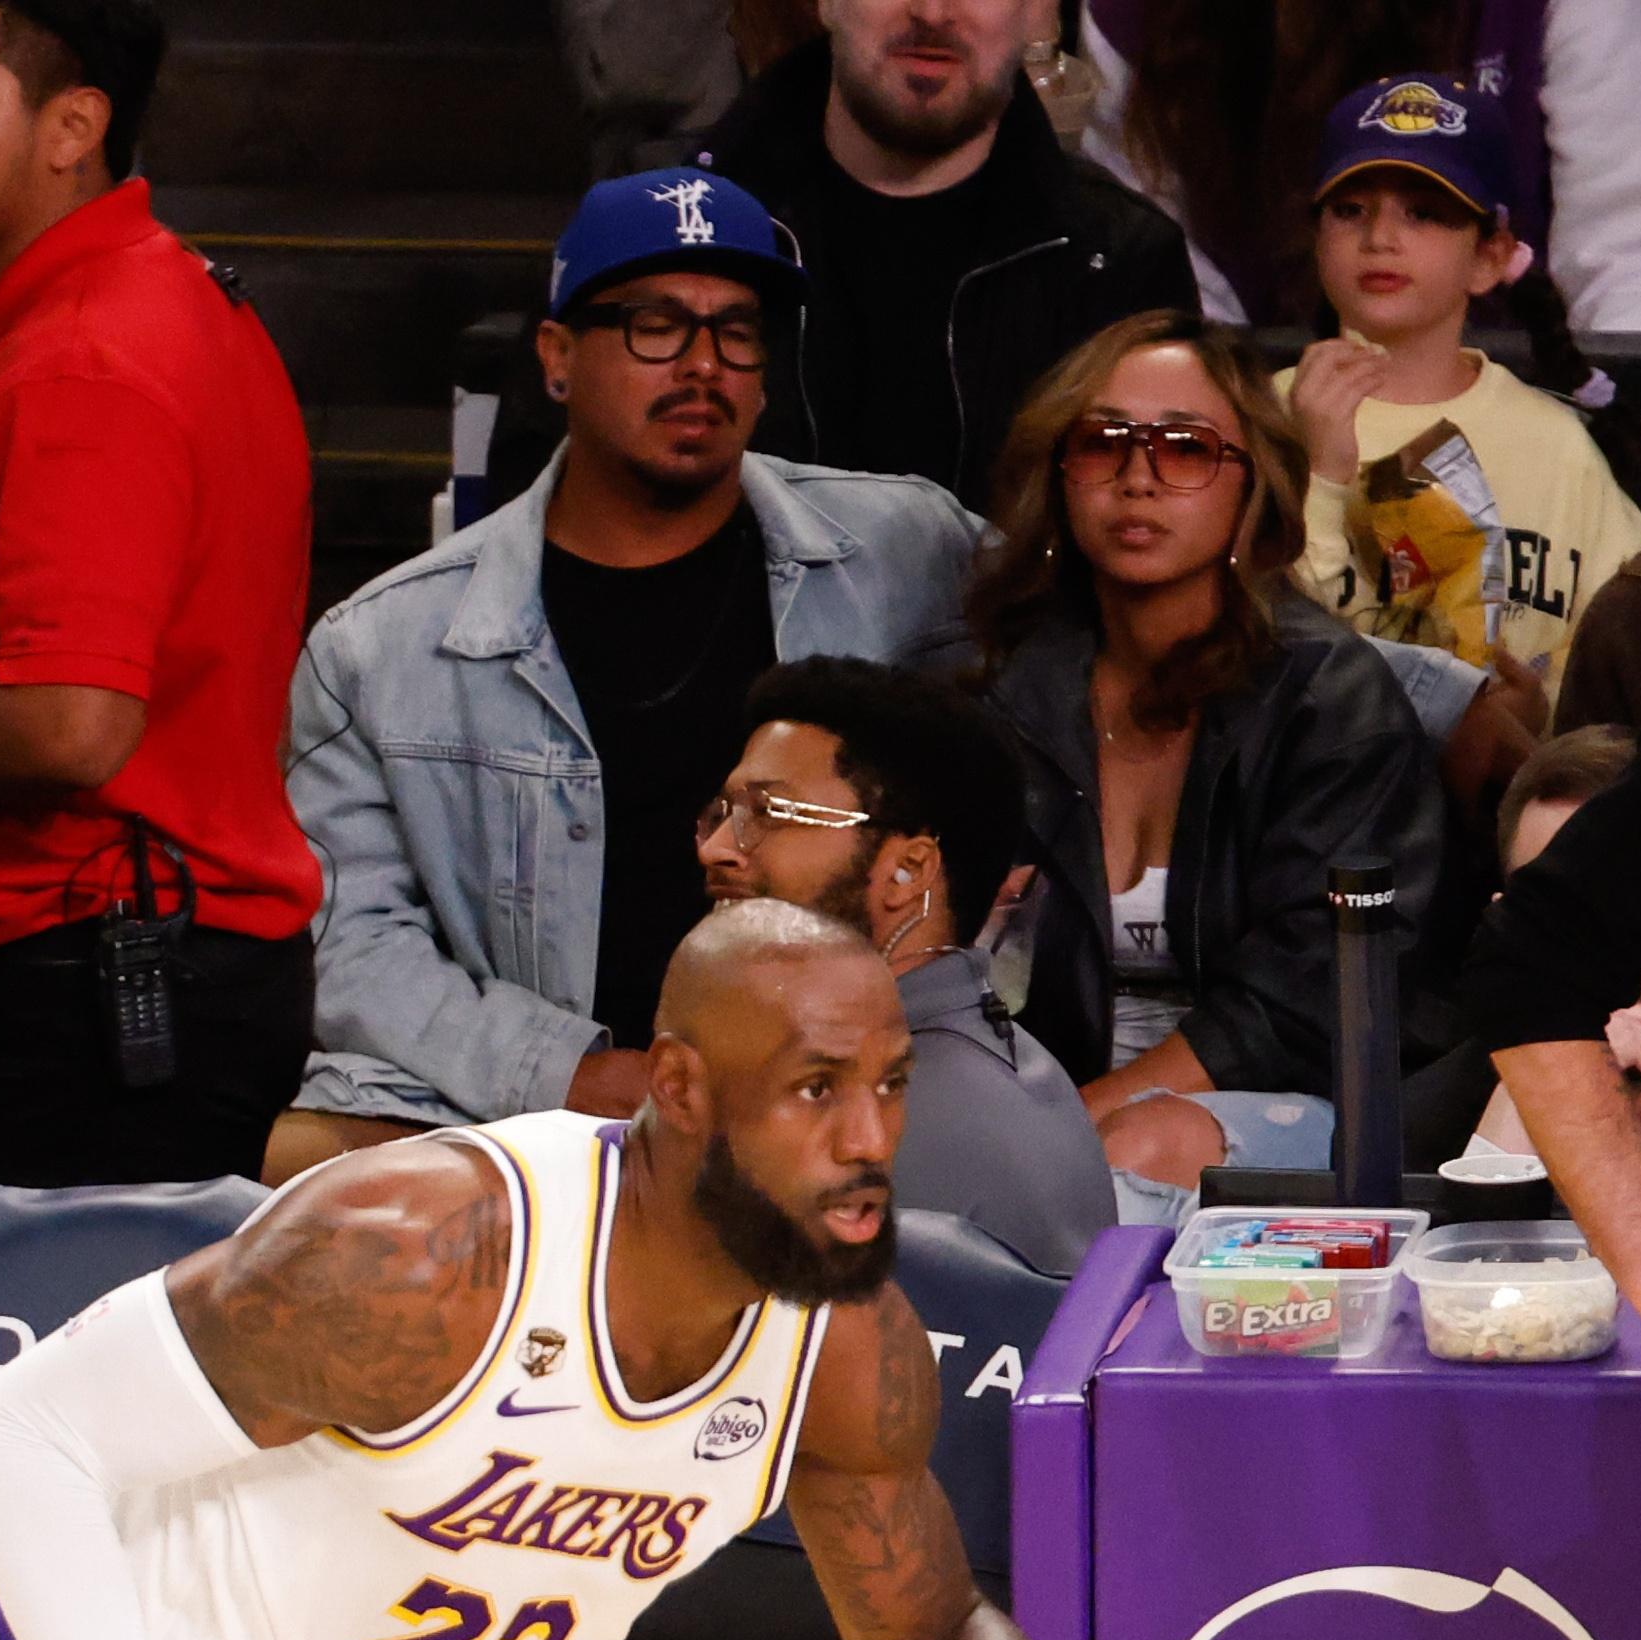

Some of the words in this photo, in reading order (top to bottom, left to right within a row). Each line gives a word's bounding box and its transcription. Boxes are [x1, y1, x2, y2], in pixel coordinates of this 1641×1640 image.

[1241, 1298, 1333, 1337] Extra
[704, 1413, 759, 1443] bibigo
[378, 1447, 712, 1581] LAKERS
